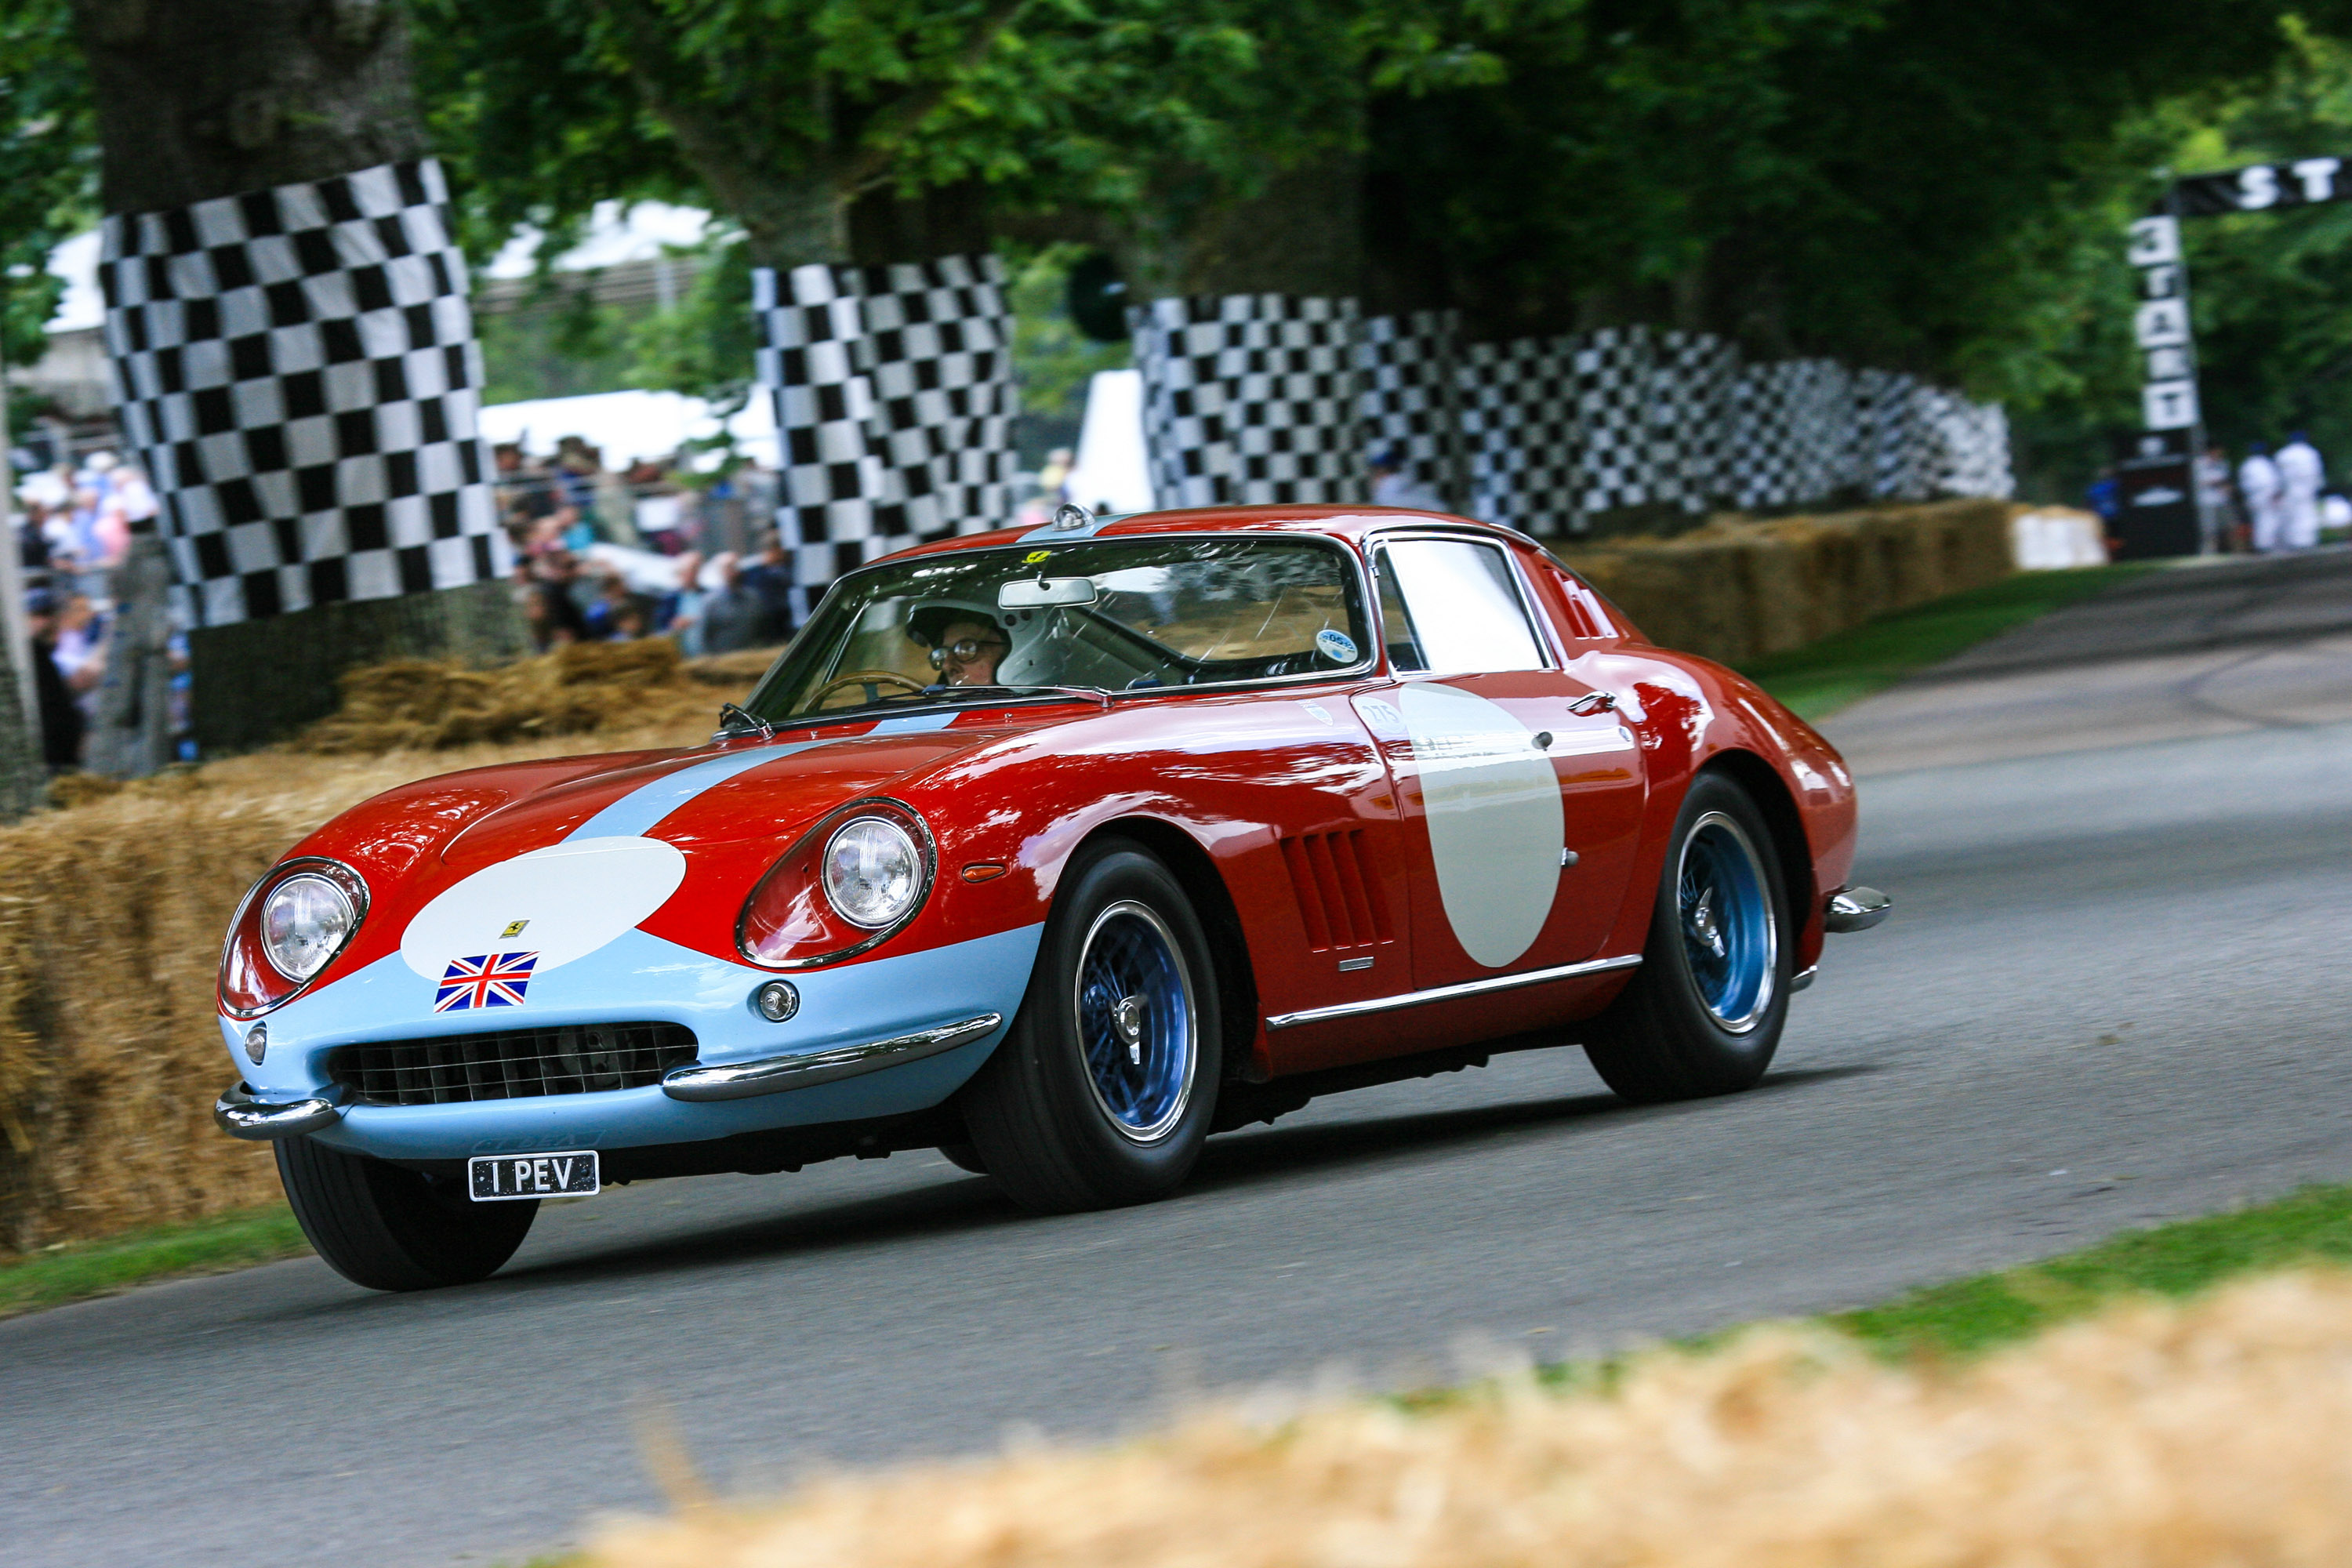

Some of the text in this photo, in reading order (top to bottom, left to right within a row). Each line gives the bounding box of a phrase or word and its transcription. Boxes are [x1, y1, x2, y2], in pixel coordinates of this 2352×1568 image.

[2132, 219, 2194, 424] STAT
[1361, 705, 1399, 723] 275
[514, 1158, 574, 1192] PEV
